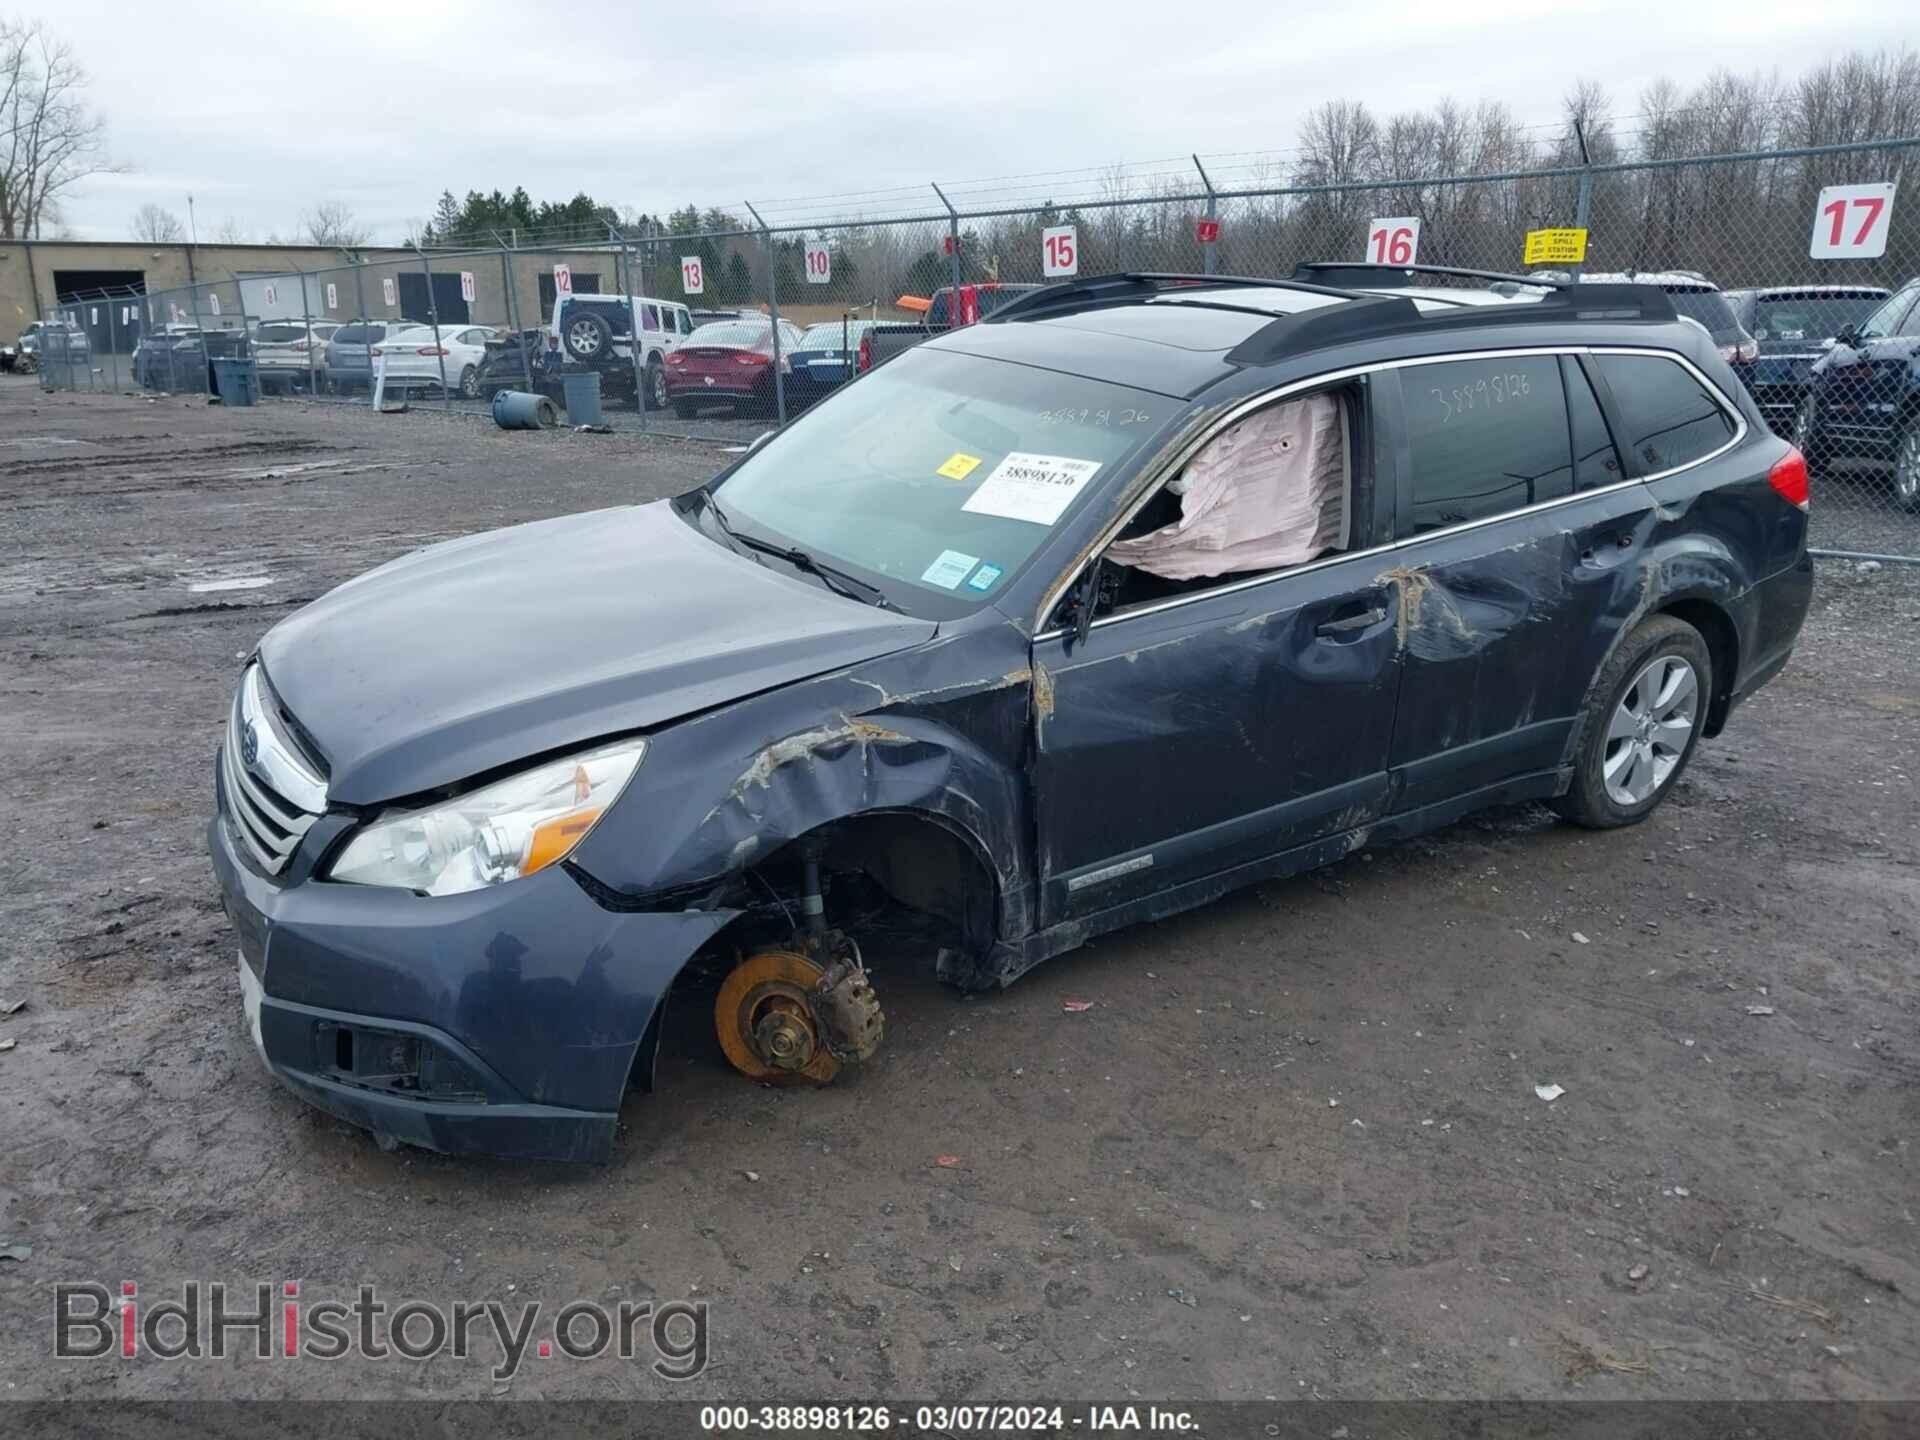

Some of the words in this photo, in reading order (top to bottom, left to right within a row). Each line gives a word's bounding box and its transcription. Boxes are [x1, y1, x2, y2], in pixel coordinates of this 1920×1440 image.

[1823, 197, 1885, 246] 17
[1045, 235, 1074, 268] 15
[1372, 227, 1413, 265] 16
[807, 250, 828, 275] 10
[463, 277, 474, 297] 11
[556, 270, 570, 292] 12
[684, 264, 701, 288] 13
[1000, 465, 1076, 487] 38898126
